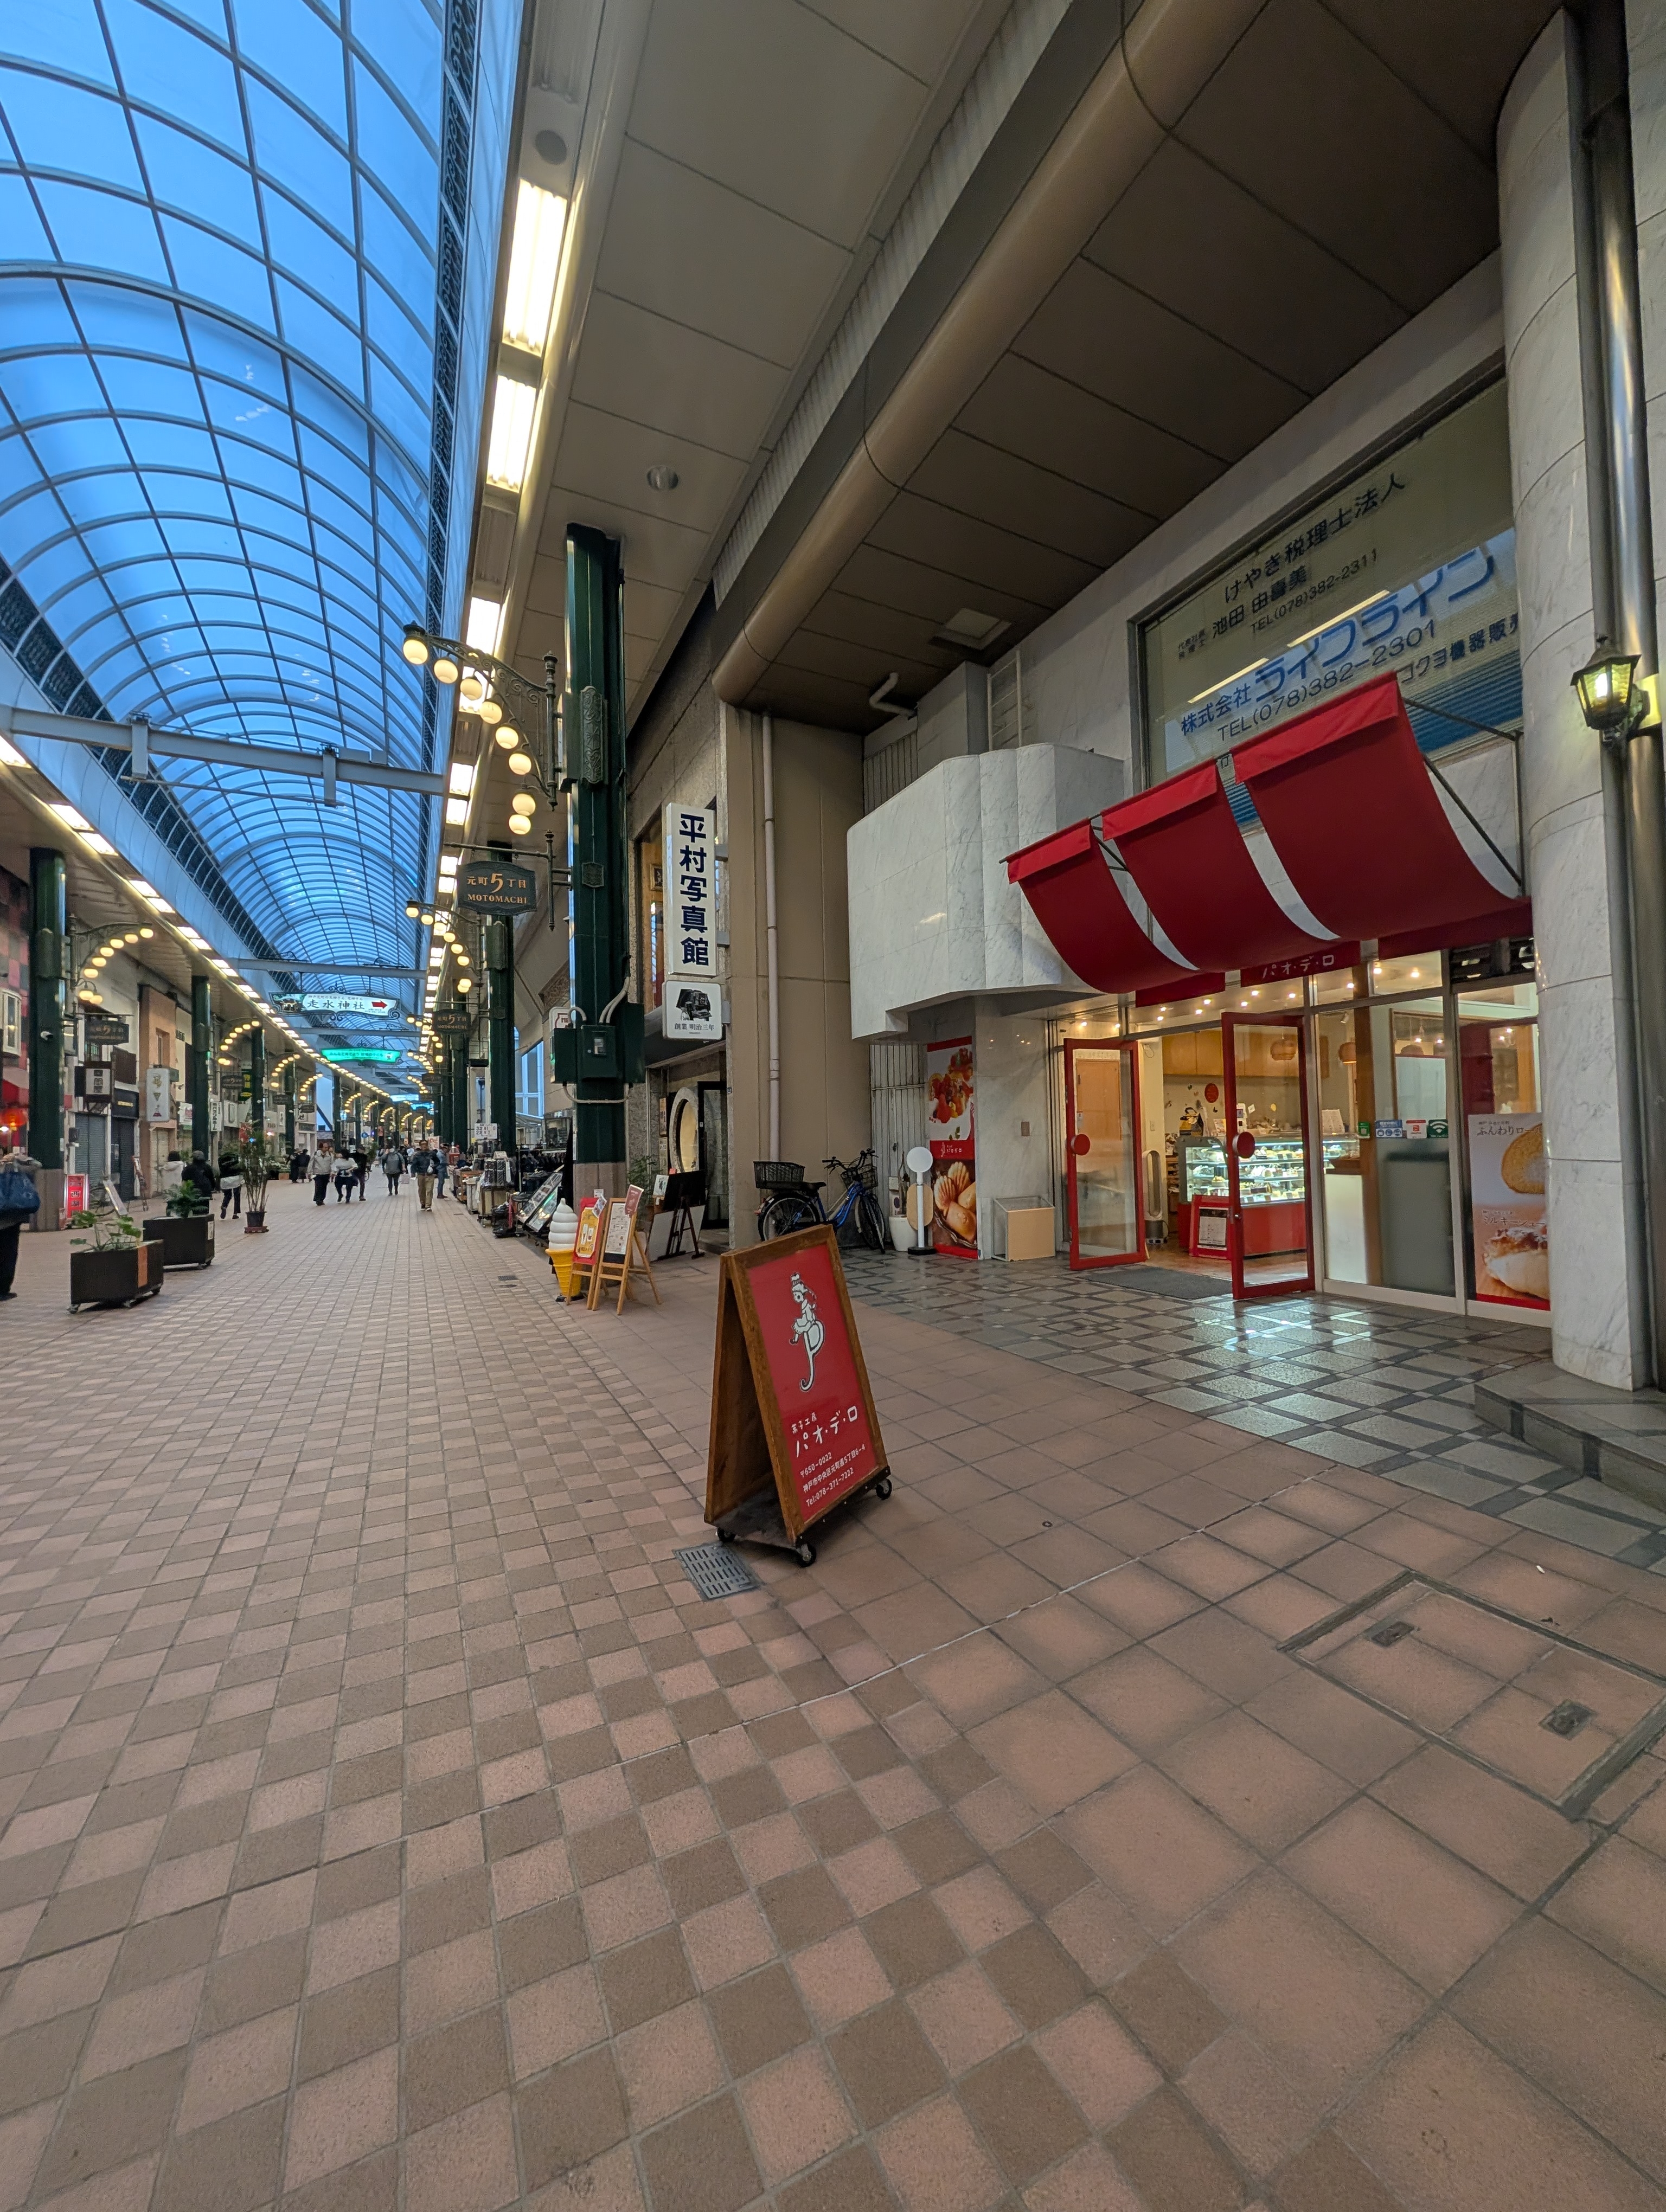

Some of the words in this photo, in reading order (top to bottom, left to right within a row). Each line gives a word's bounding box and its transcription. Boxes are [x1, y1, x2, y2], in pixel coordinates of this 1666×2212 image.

[1225, 472, 1405, 603] けやき税理士法人
[1217, 619, 1436, 741] TEL(078)382-2301
[467, 873, 526, 893] 元町5丁目
[467, 893, 527, 904] MOTOMACHI
[679, 813, 709, 966] 平村写真館
[307, 999, 365, 1009] 走水神社
[805, 1467, 854, 1508] Tel:078-371-7222
